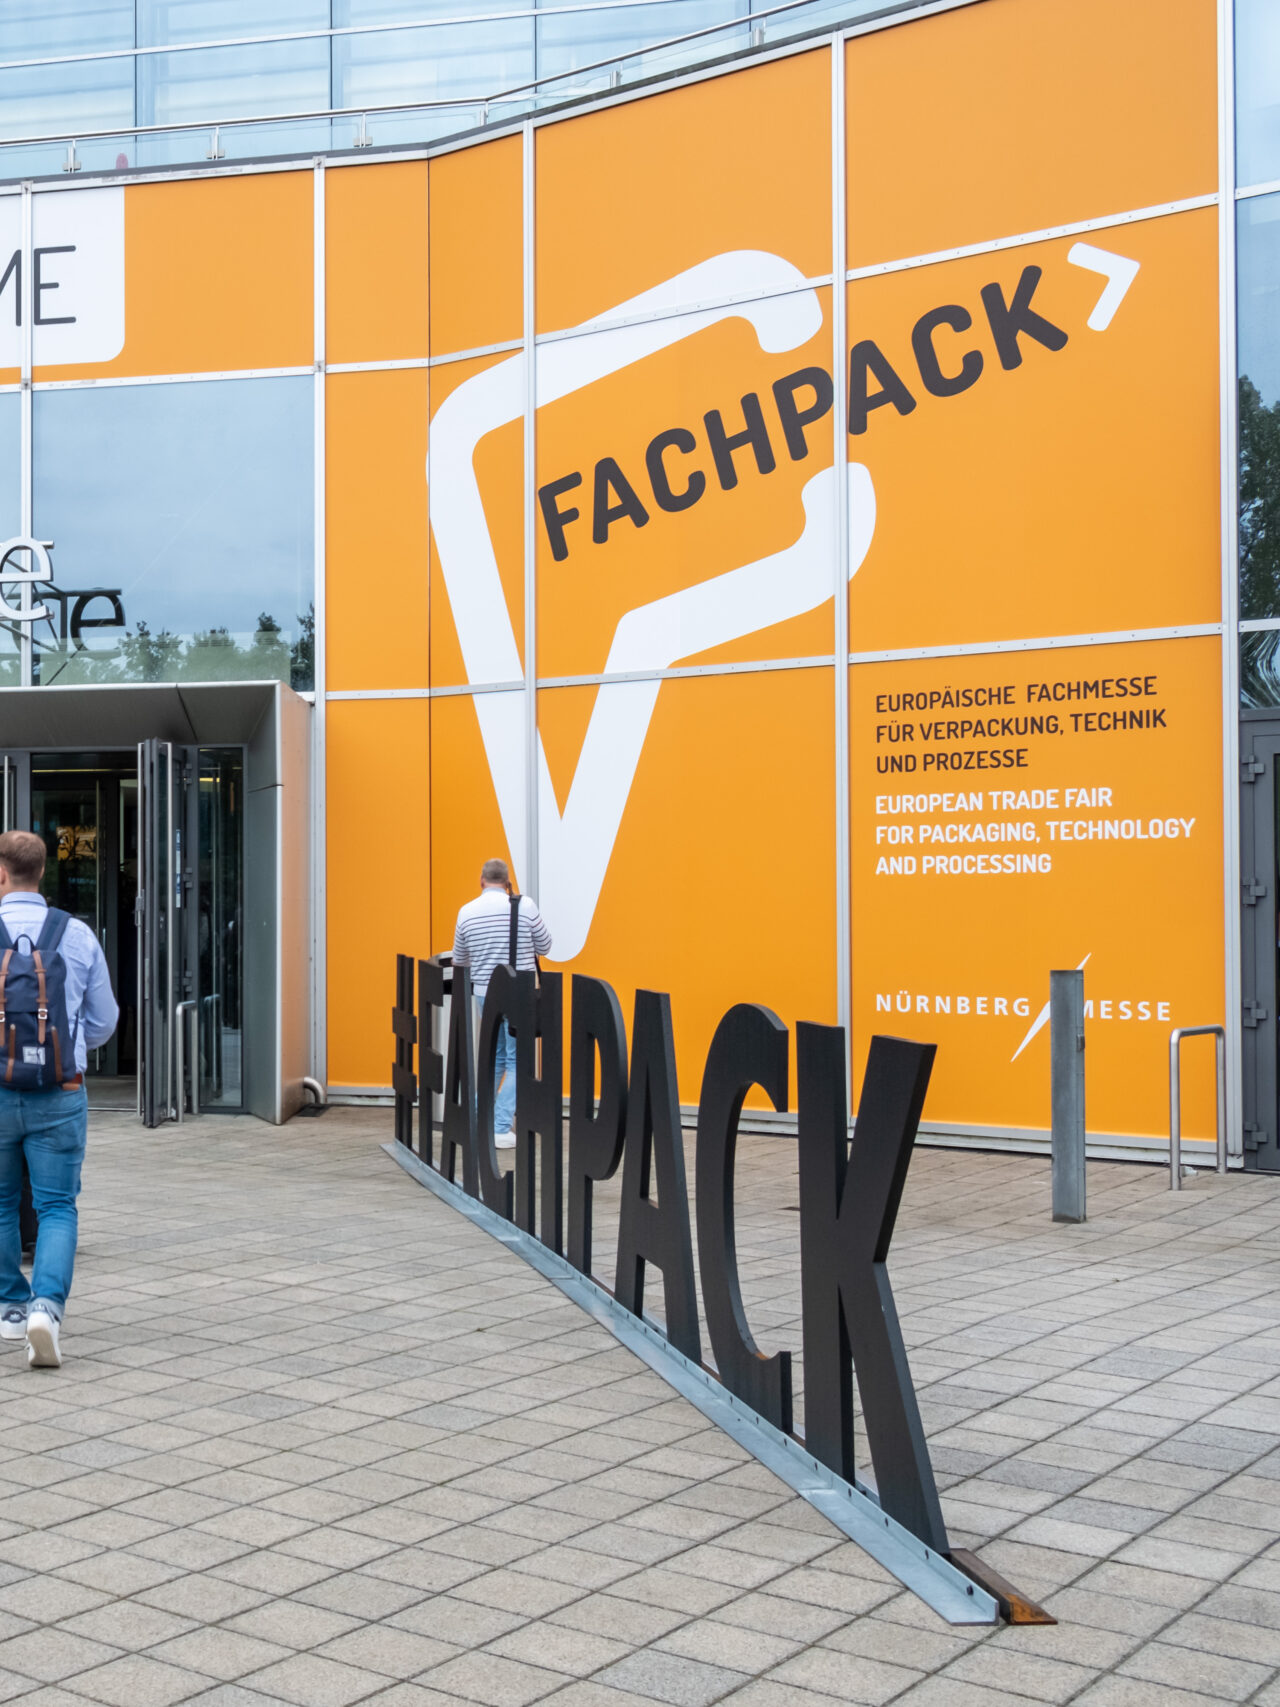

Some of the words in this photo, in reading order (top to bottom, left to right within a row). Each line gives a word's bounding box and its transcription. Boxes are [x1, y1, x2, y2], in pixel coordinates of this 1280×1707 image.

[537, 264, 1069, 563] FACHPACK
[876, 685, 1016, 713] EUROPÄISCHE
[1027, 675, 1158, 703] FACHMESSE
[876, 720, 914, 743] FÜR
[919, 715, 1064, 741] VERPACKUNG,
[1069, 708, 1167, 733] TECHNIK
[876, 754, 917, 774] UND
[923, 748, 1029, 772] PROZESSE
[875, 792, 984, 815] EUROPEAN
[988, 789, 1060, 811] TRADE
[1064, 787, 1113, 809] FAIR
[875, 825, 914, 845] FOR
[918, 821, 1041, 844] PACKAGING,
[1045, 817, 1196, 841] TECHNOLOGY
[875, 855, 917, 875] AND
[922, 853, 1052, 875] PROCESSING
[876, 989, 1030, 1018] NÜRNBERG
